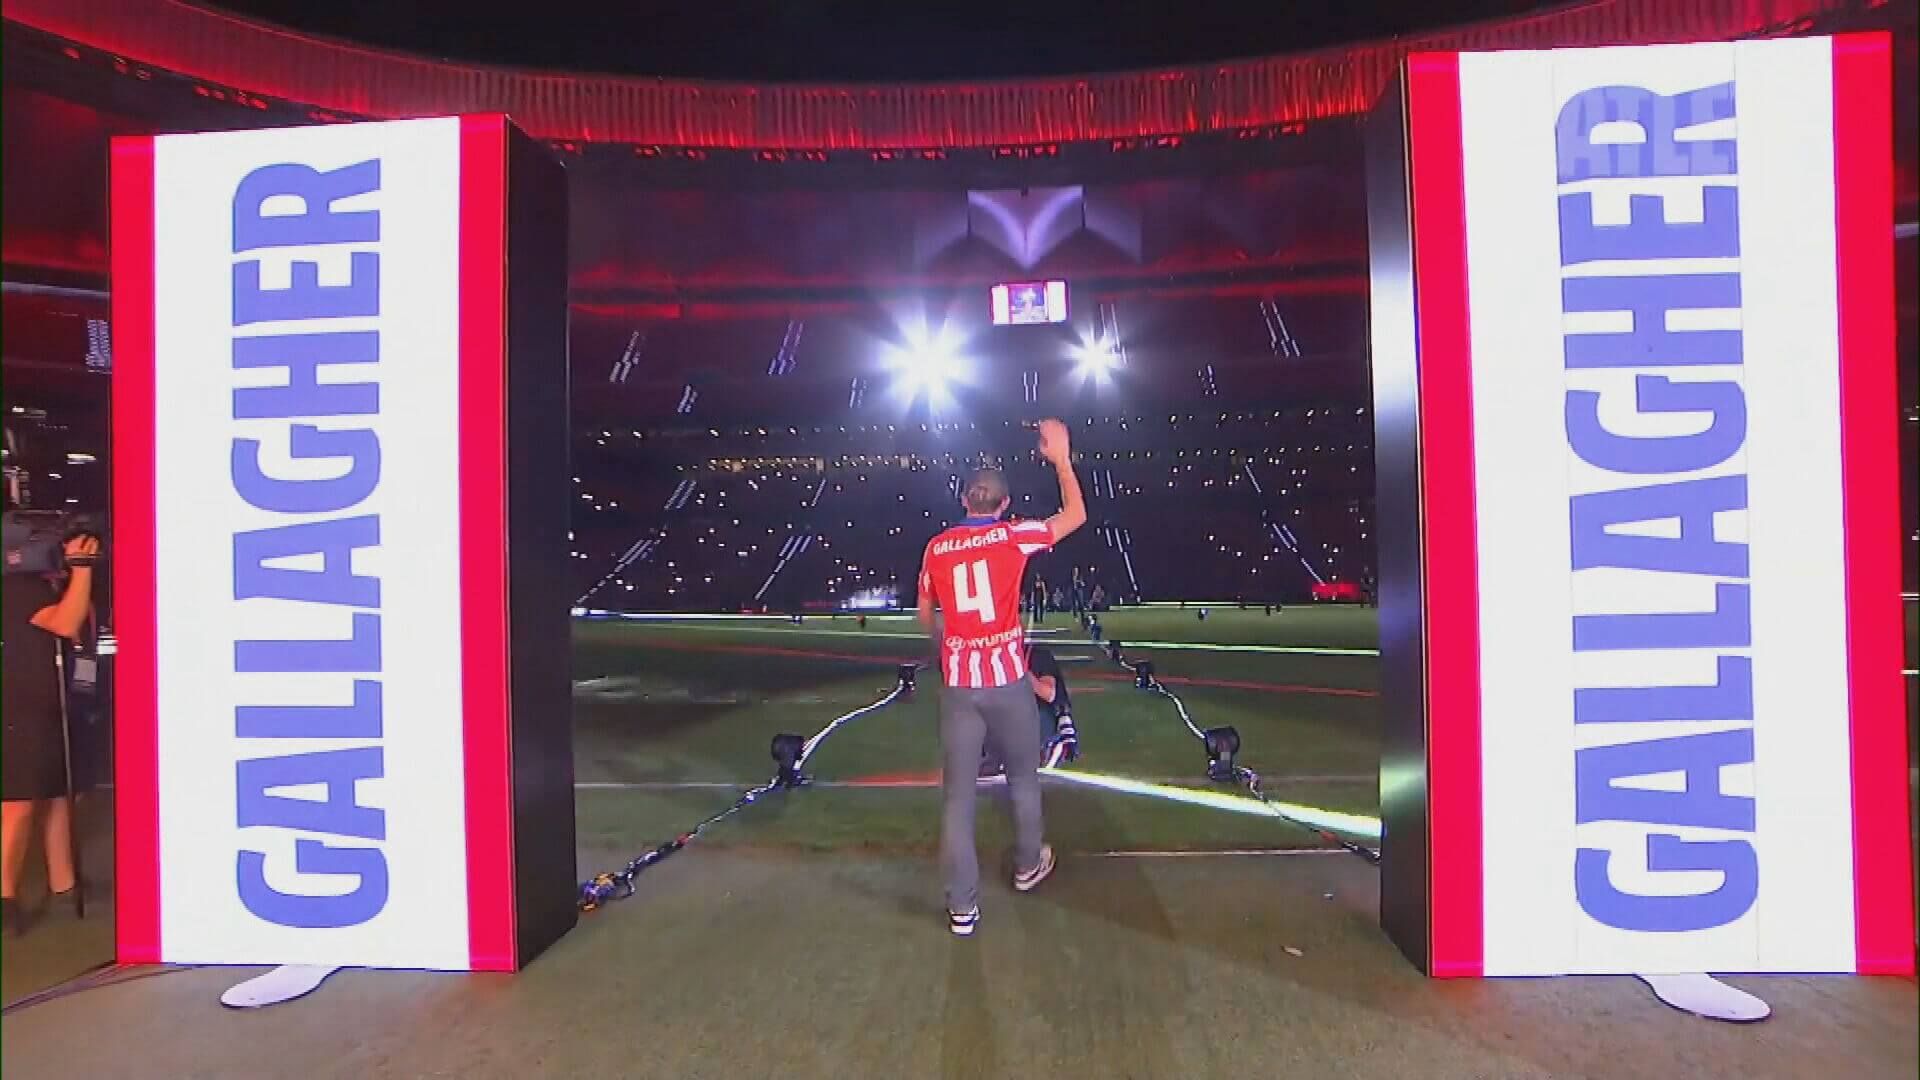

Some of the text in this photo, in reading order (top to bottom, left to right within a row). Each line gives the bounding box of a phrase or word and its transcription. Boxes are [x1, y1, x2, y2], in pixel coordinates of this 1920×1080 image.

[230, 158, 389, 929] GALLAGHER
[933, 527, 1009, 555] GALLAGHER
[952, 559, 996, 623] 4
[1556, 80, 1759, 933] GALLAGHER
